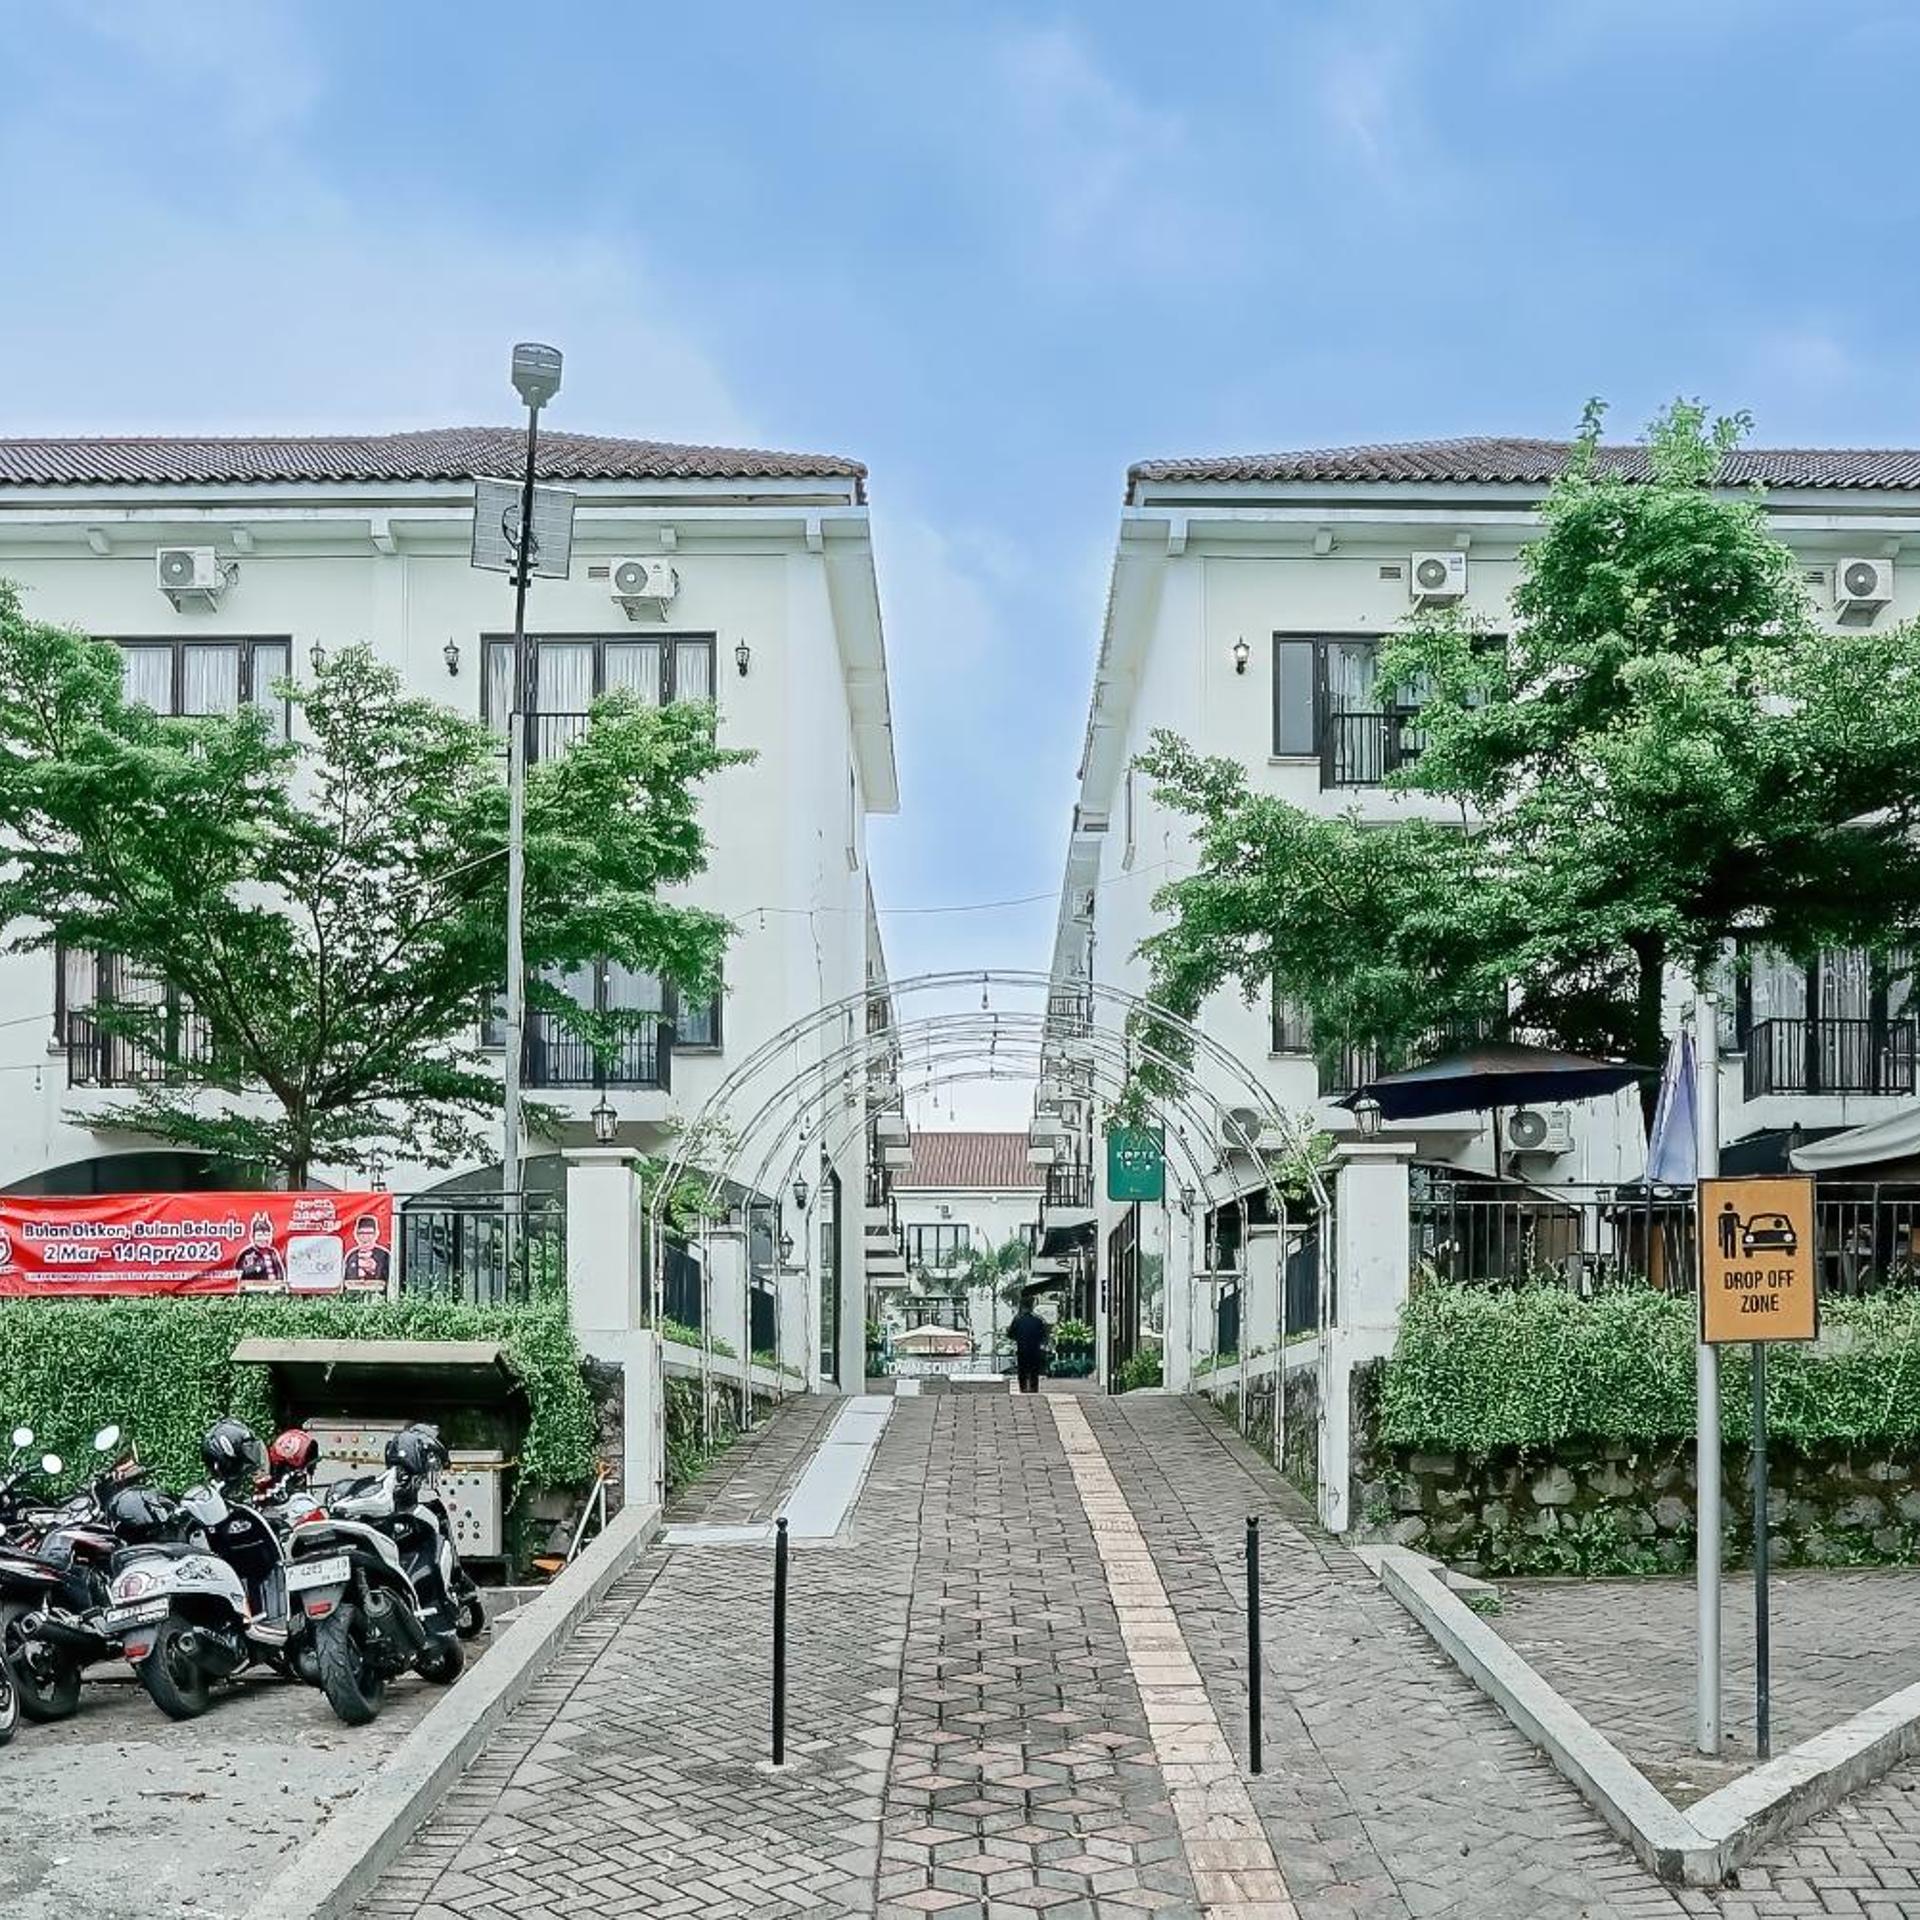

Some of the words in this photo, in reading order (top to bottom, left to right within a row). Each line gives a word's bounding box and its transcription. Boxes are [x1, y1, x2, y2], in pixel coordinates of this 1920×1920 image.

[24, 1222, 70, 1238] Bulan
[72, 1222, 131, 1239] Diskon,
[134, 1221, 180, 1237] Bulan
[183, 1220, 243, 1240] Belanja
[45, 1246, 58, 1262] 2
[60, 1245, 97, 1262] Mar
[113, 1244, 136, 1261] 14
[138, 1244, 175, 1264] Apr
[176, 1243, 221, 1260] 2024
[1724, 1271, 1763, 1290] DROP
[1768, 1270, 1795, 1288] OFF
[1740, 1294, 1780, 1313] ZONE
